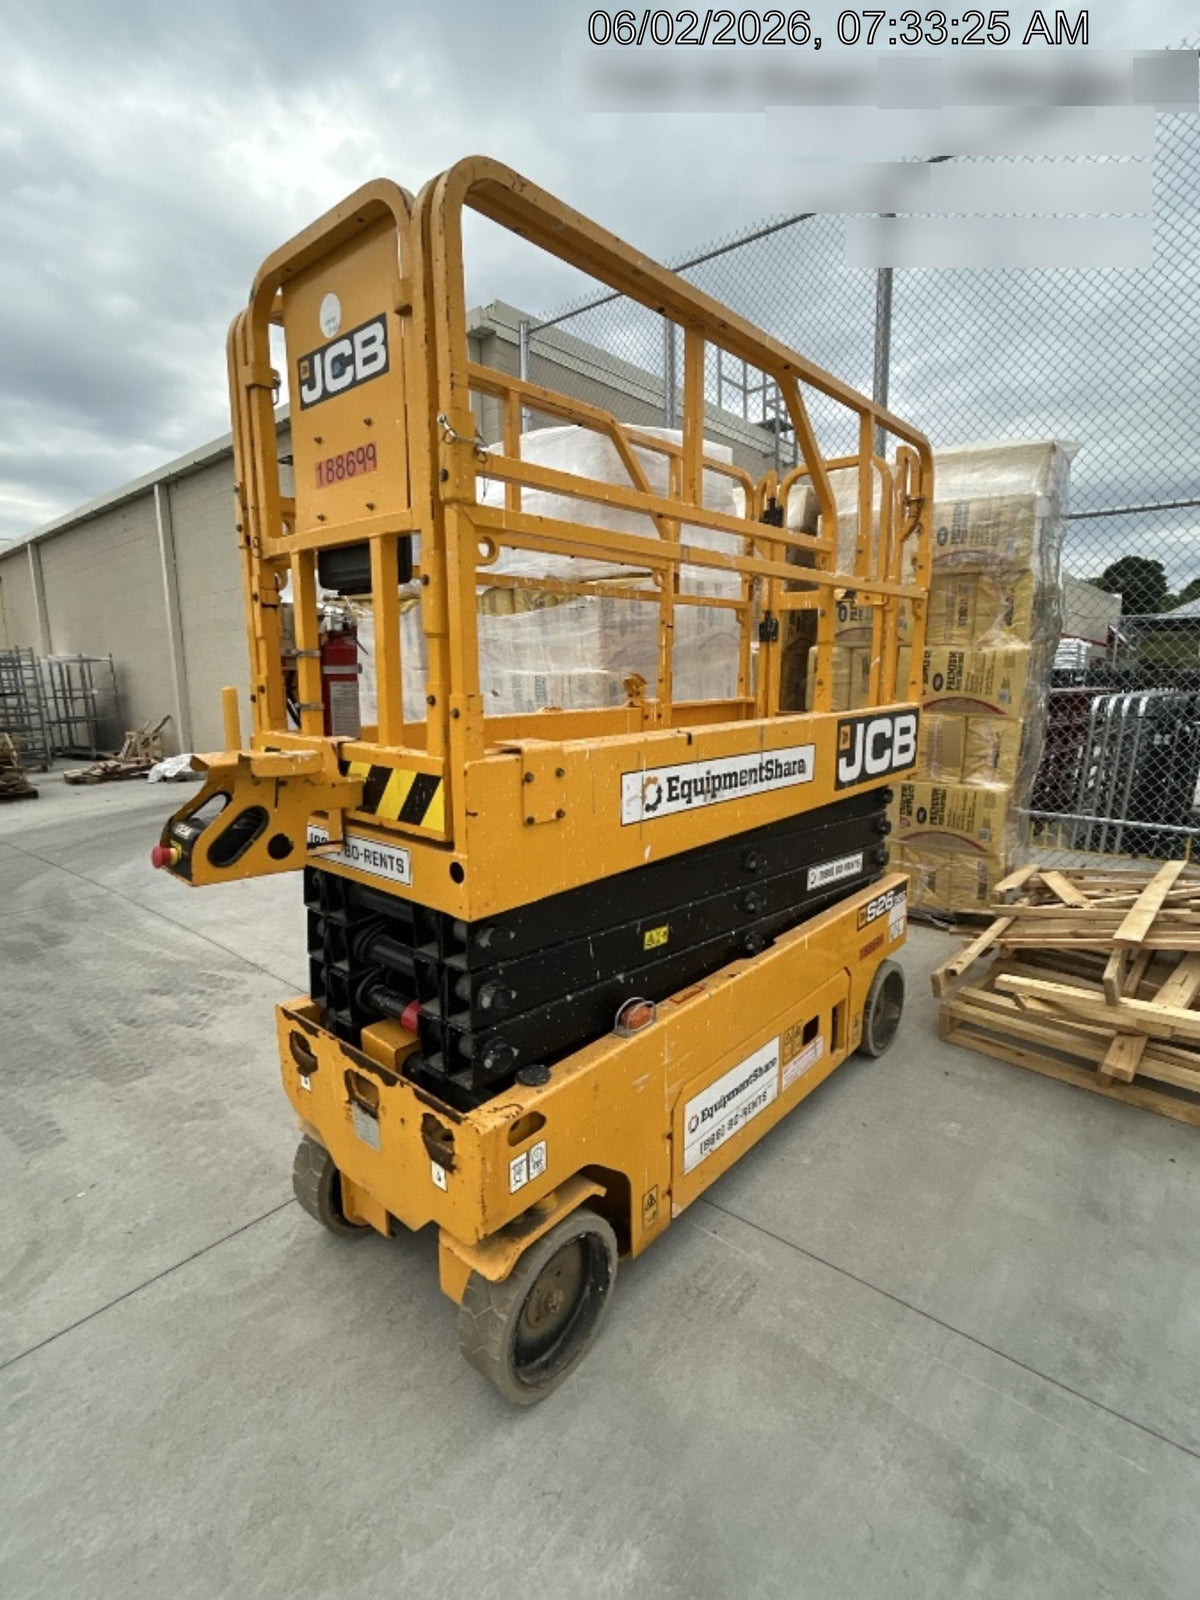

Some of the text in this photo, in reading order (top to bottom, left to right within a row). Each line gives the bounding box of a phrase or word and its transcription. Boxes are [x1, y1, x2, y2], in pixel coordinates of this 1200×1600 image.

[301, 321, 387, 404] JCB
[316, 443, 377, 487] 188699
[666, 757, 807, 803] EquipmentShare
[838, 714, 917, 783] JCB
[700, 1057, 777, 1123] EquipmentShare
